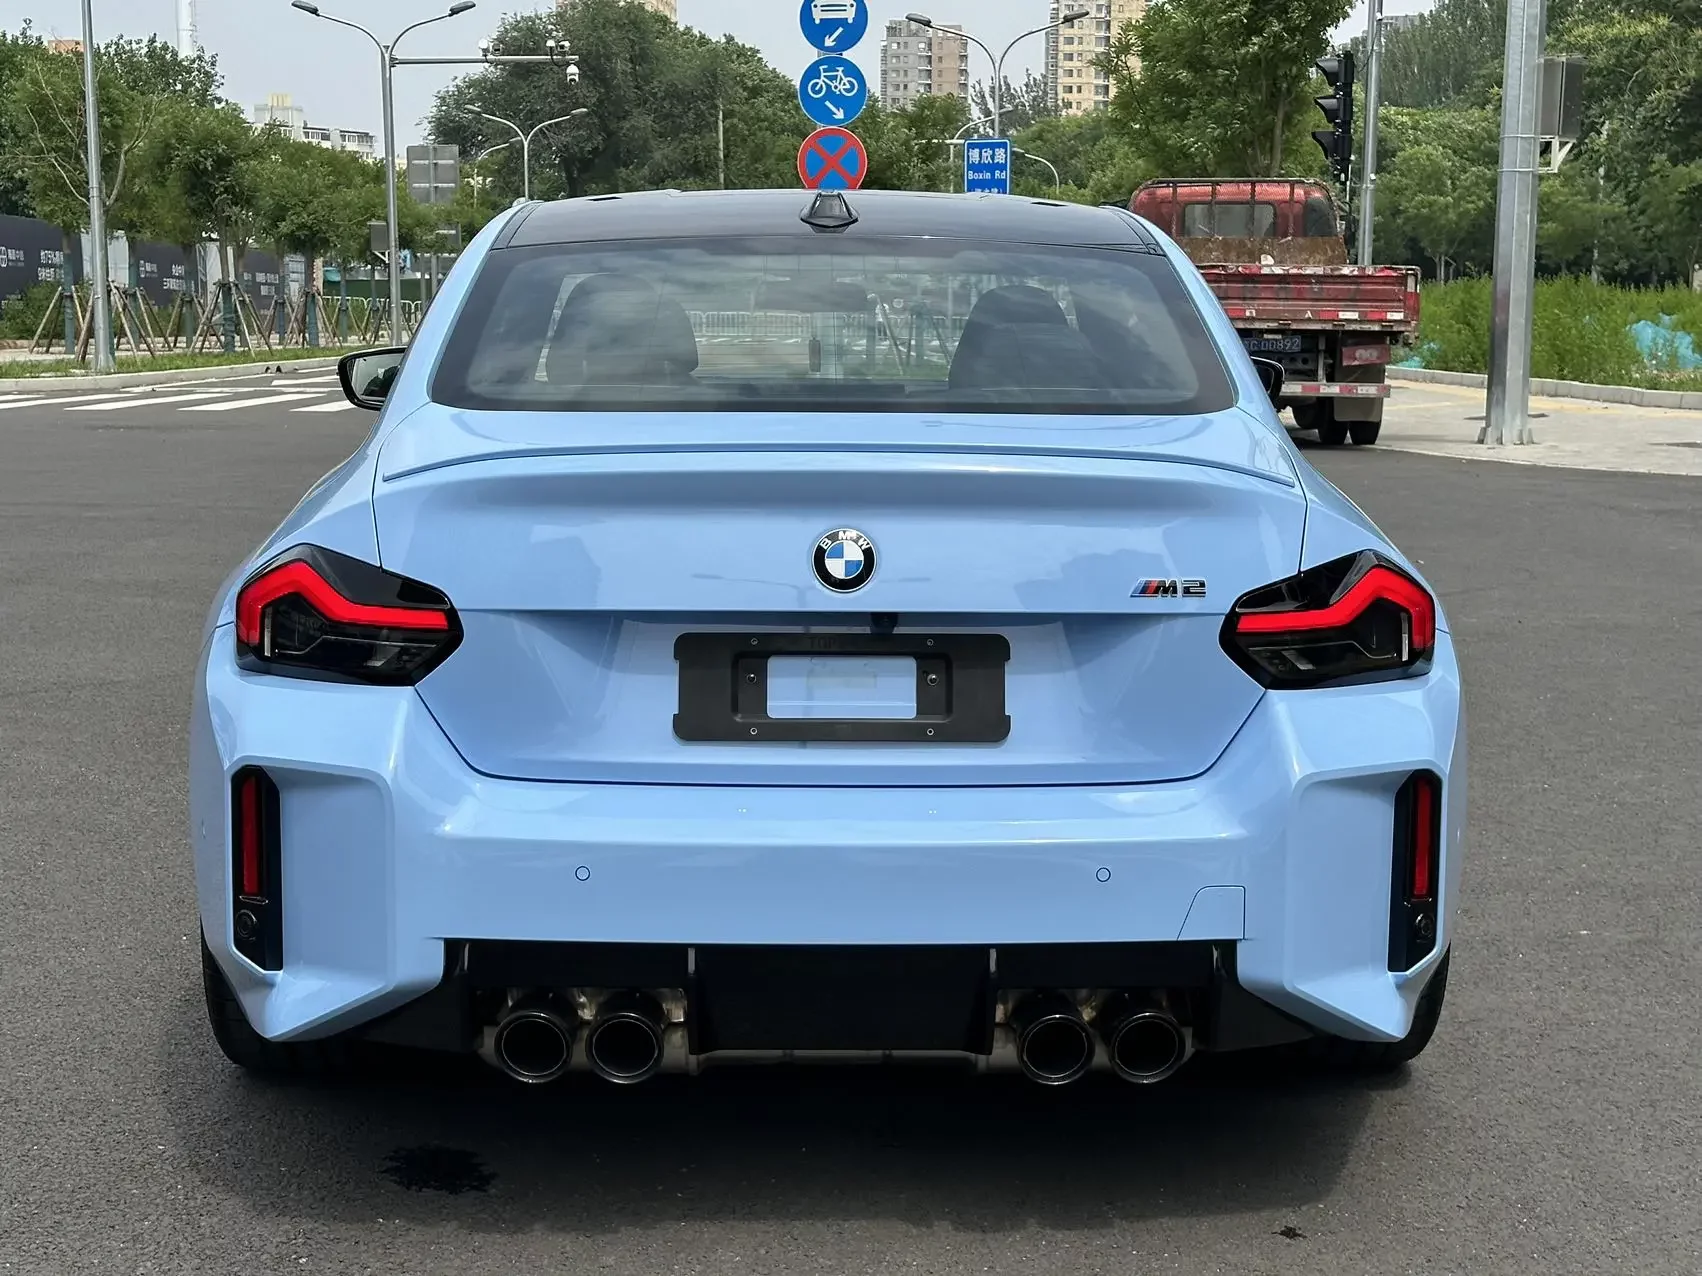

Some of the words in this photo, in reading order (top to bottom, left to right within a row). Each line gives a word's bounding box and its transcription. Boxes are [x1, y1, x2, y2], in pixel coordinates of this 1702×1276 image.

[968, 148, 1006, 164] 博欣路
[968, 170, 991, 179] Boxin
[995, 170, 1006, 179] Rd
[819, 530, 871, 550] BMW
[1132, 578, 1207, 598] M2
